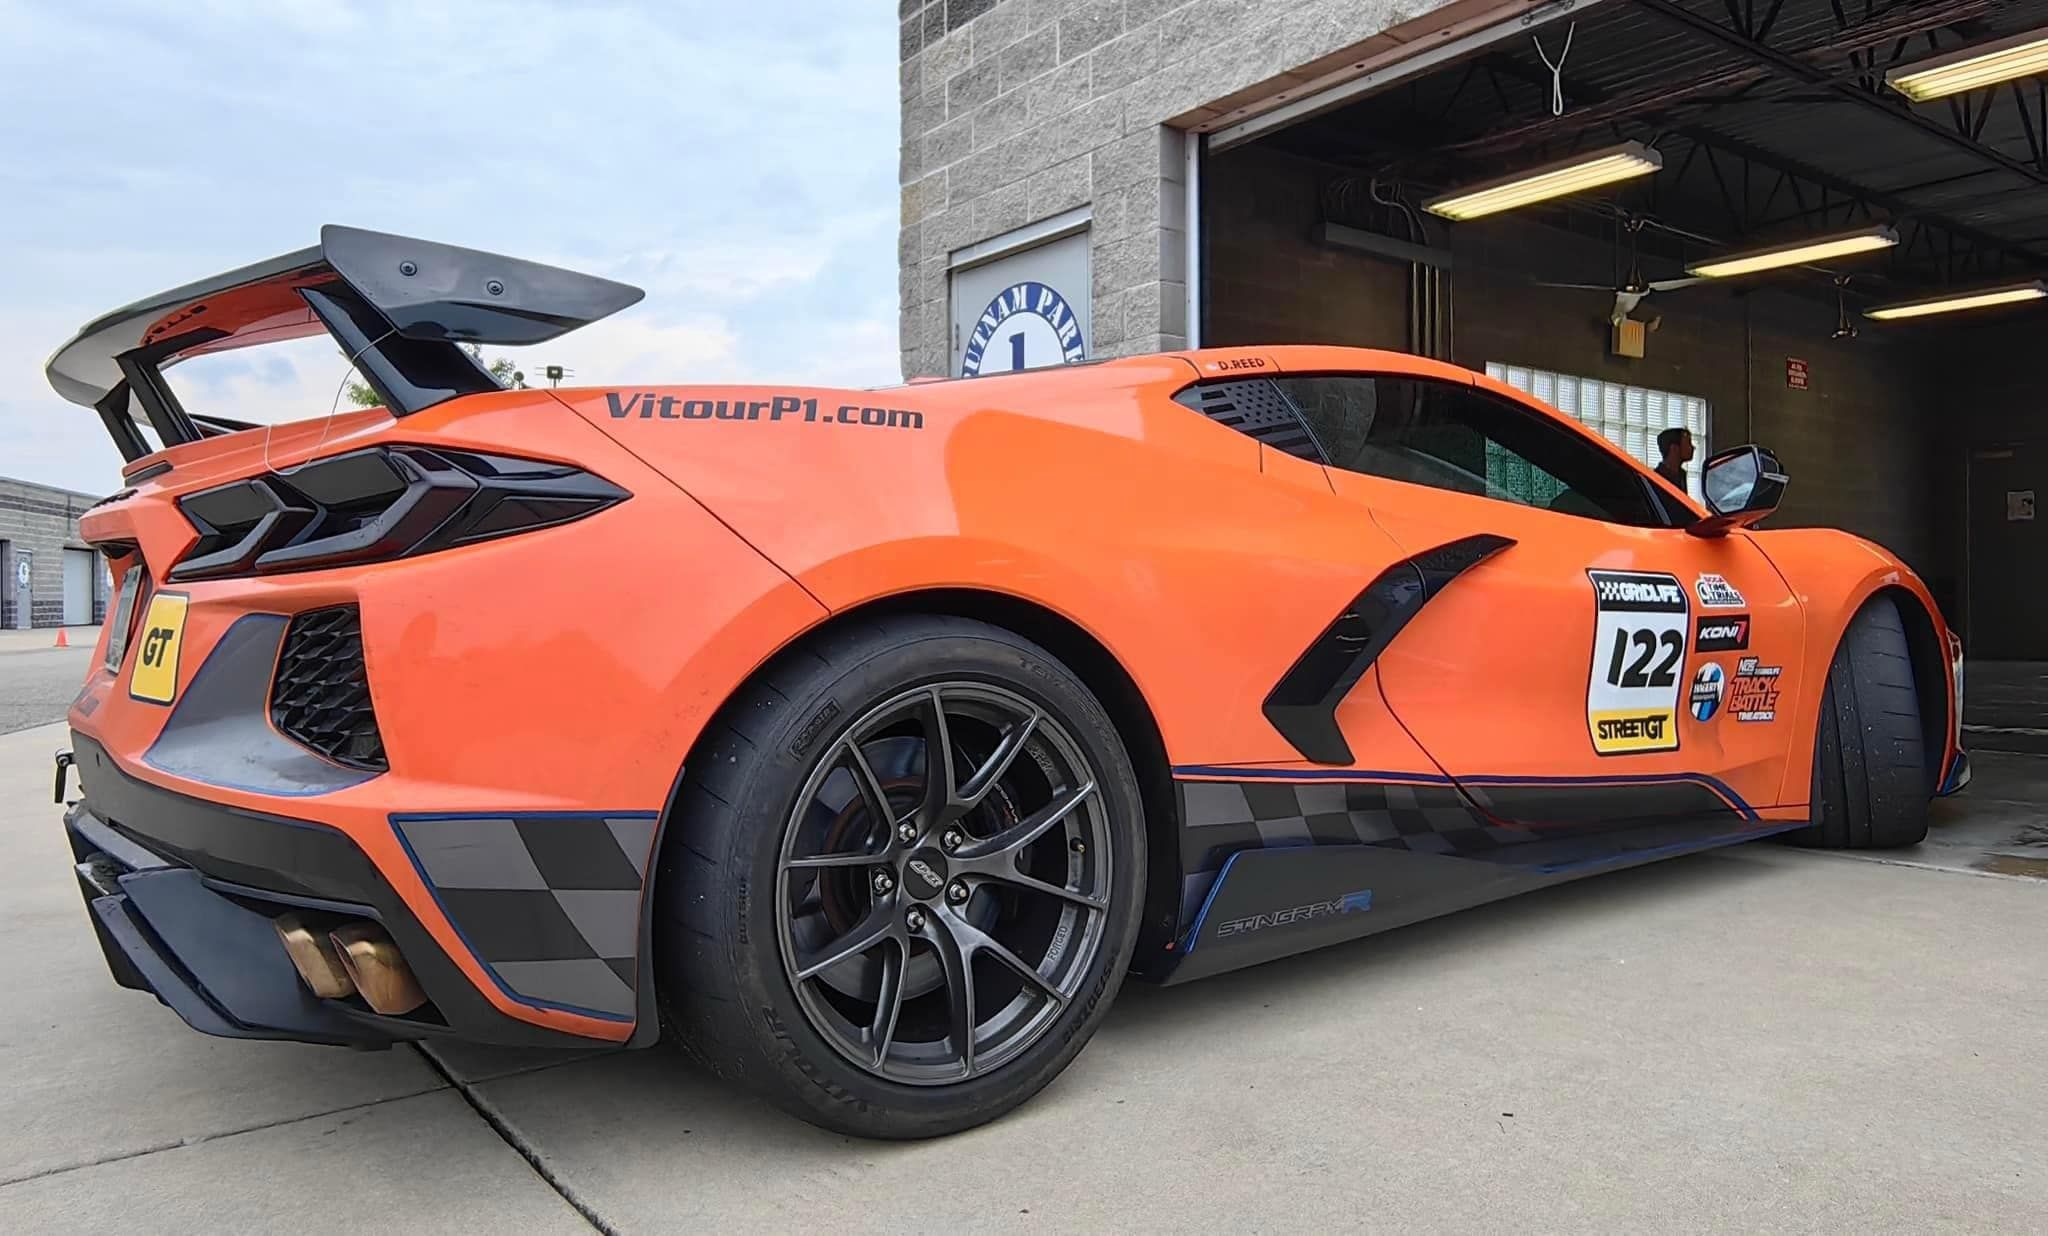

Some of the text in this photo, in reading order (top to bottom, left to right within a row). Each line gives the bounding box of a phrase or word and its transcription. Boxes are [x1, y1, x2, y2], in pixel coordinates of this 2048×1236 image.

[963, 286, 1027, 377] UTNAM
[1009, 332, 1024, 370] 1
[1218, 358, 1264, 370] D.REED
[606, 392, 923, 429] VitourP1.com
[1619, 582, 1681, 603] GRIDLIFE
[143, 627, 174, 667] GT
[1699, 625, 1739, 640] KONI
[1607, 628, 1684, 688] 122
[1730, 693, 1778, 711] BATTLE
[1734, 676, 1776, 696] TRACK
[1217, 896, 1345, 937] STINGRAY
